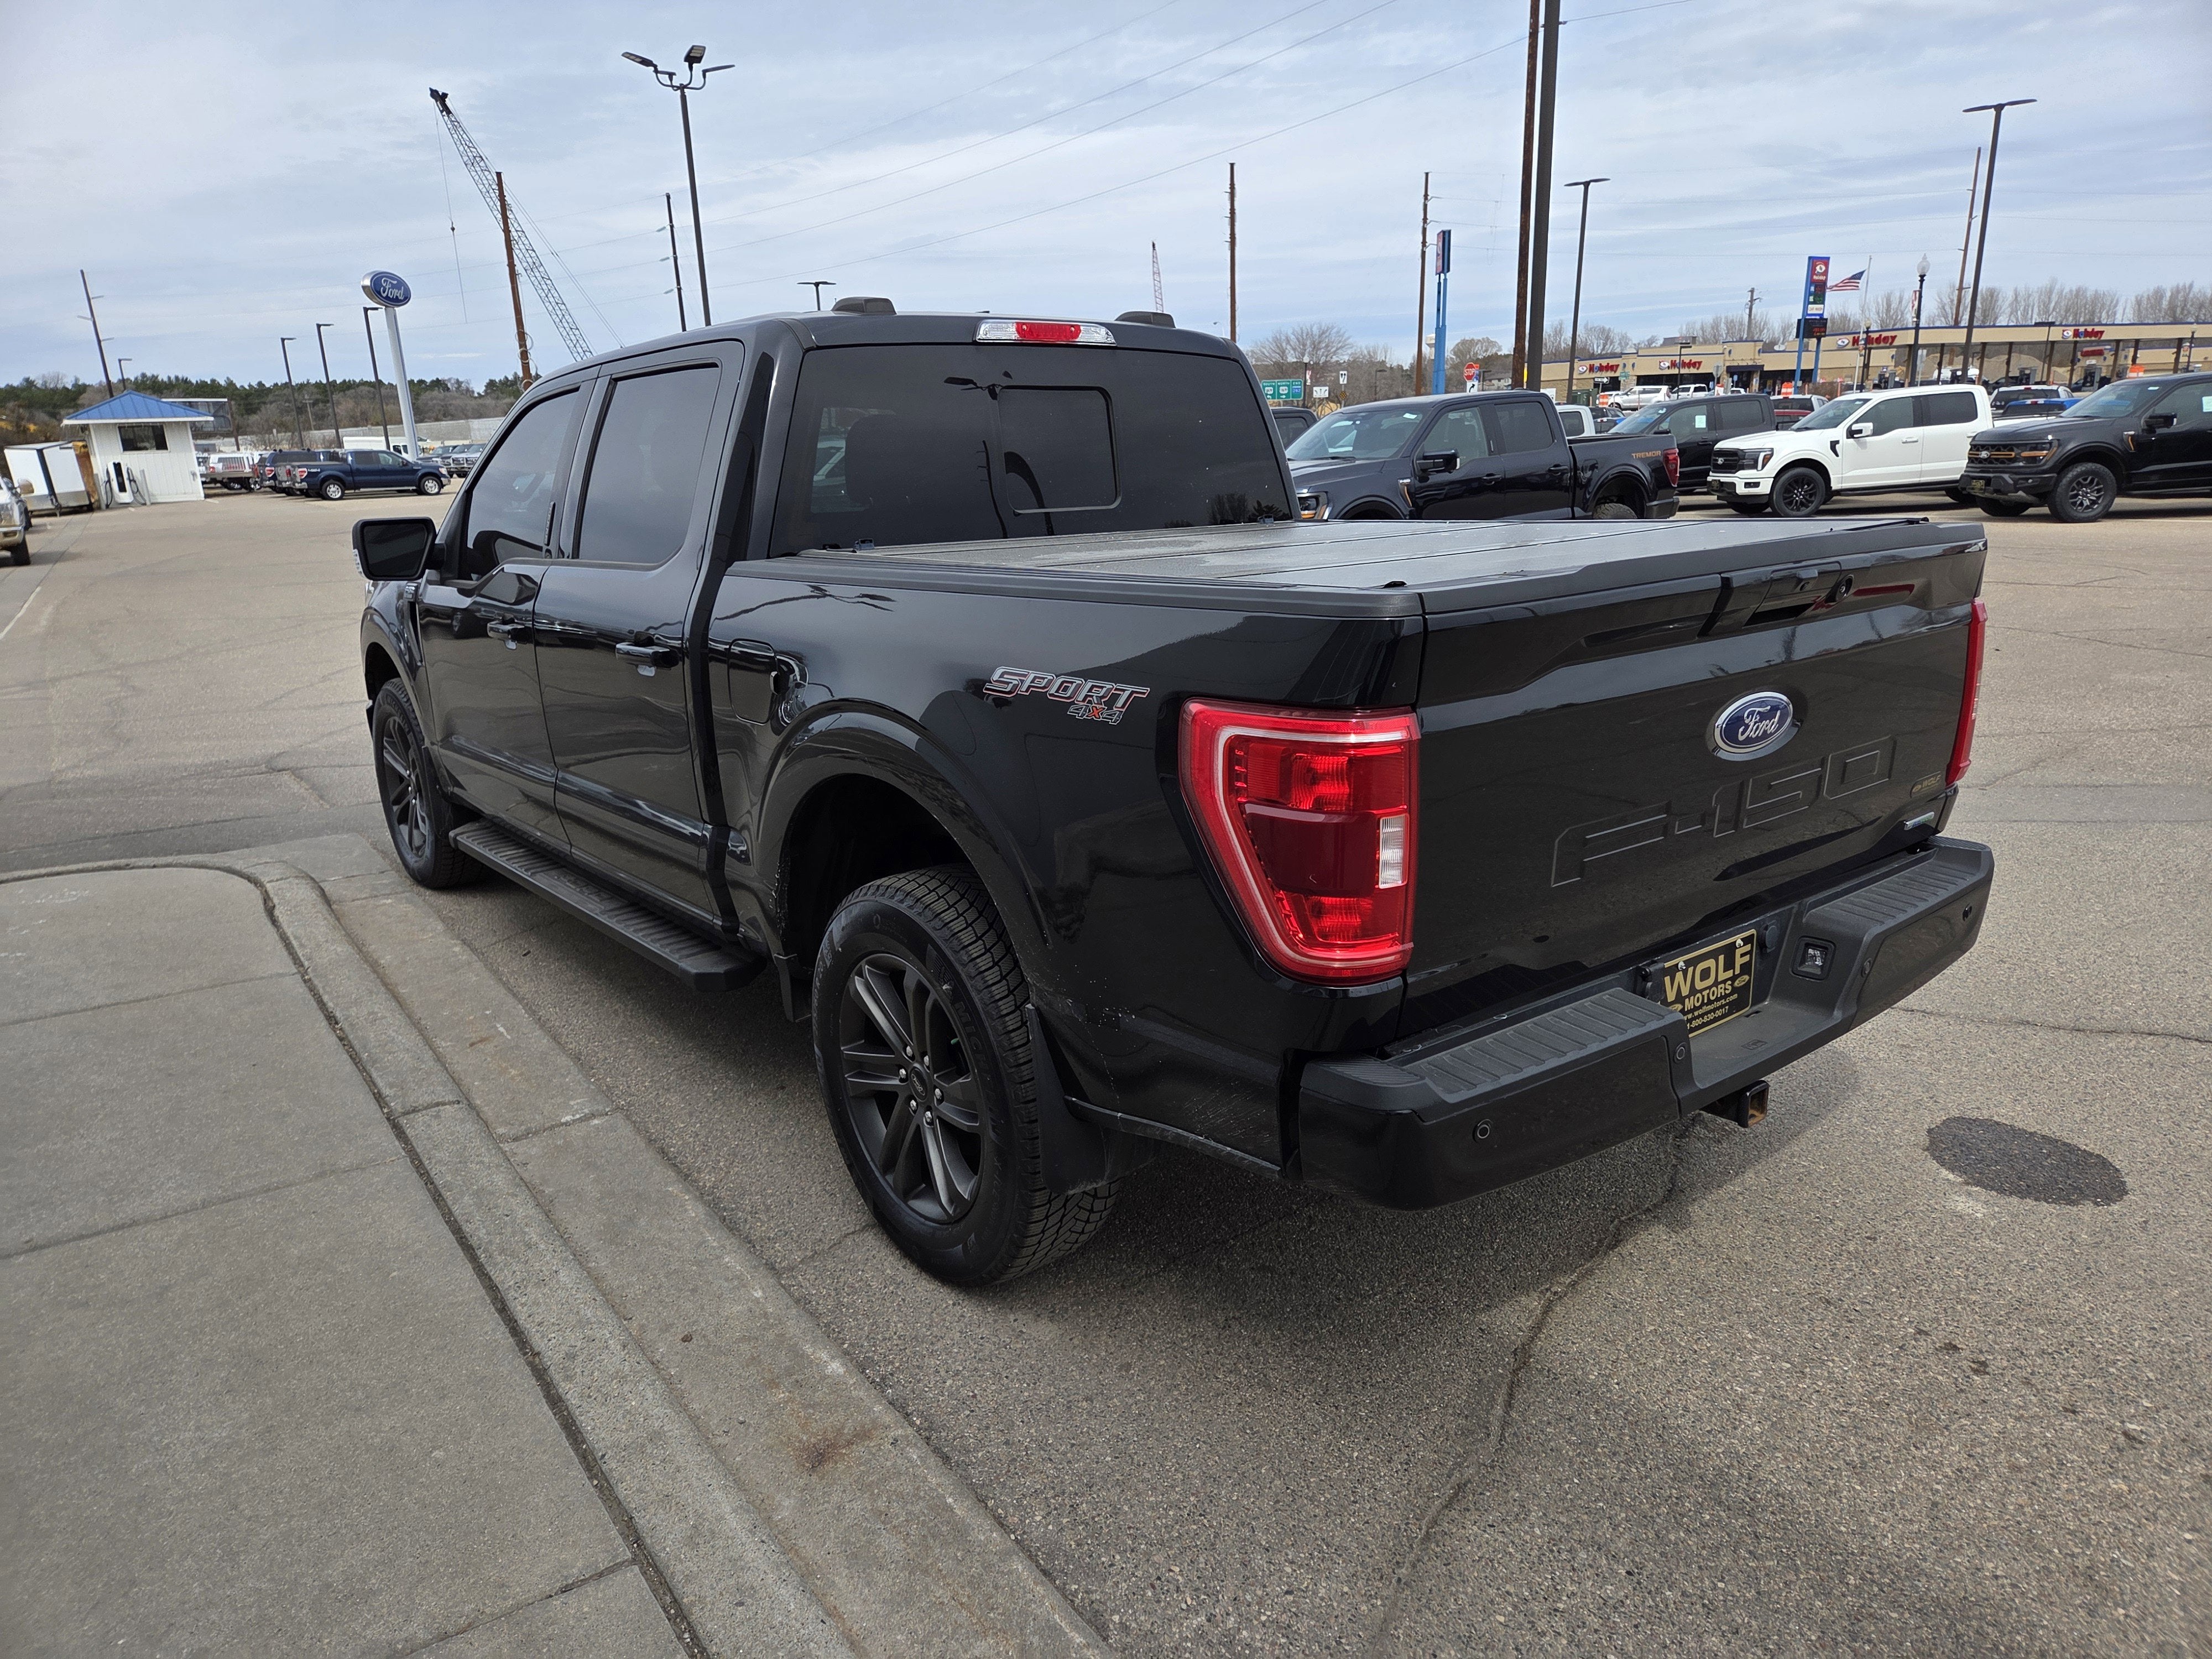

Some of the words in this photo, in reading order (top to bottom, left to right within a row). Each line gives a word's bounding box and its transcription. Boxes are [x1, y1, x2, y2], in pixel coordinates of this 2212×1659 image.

[380, 277, 404, 300] Ford
[1852, 334, 1897, 347] Hliday
[2073, 328, 2105, 340] Holiday
[1589, 363, 1620, 373] Holiday
[1631, 451, 1661, 459] TREMOR
[983, 666, 1150, 711] SPORT
[1738, 705, 1781, 741] Ford
[1922, 774, 1941, 787] WOLF
[1551, 735, 1898, 888] F-150
[1664, 943, 1751, 1003] WOLF
[1684, 980, 1732, 1011] MOTORS
